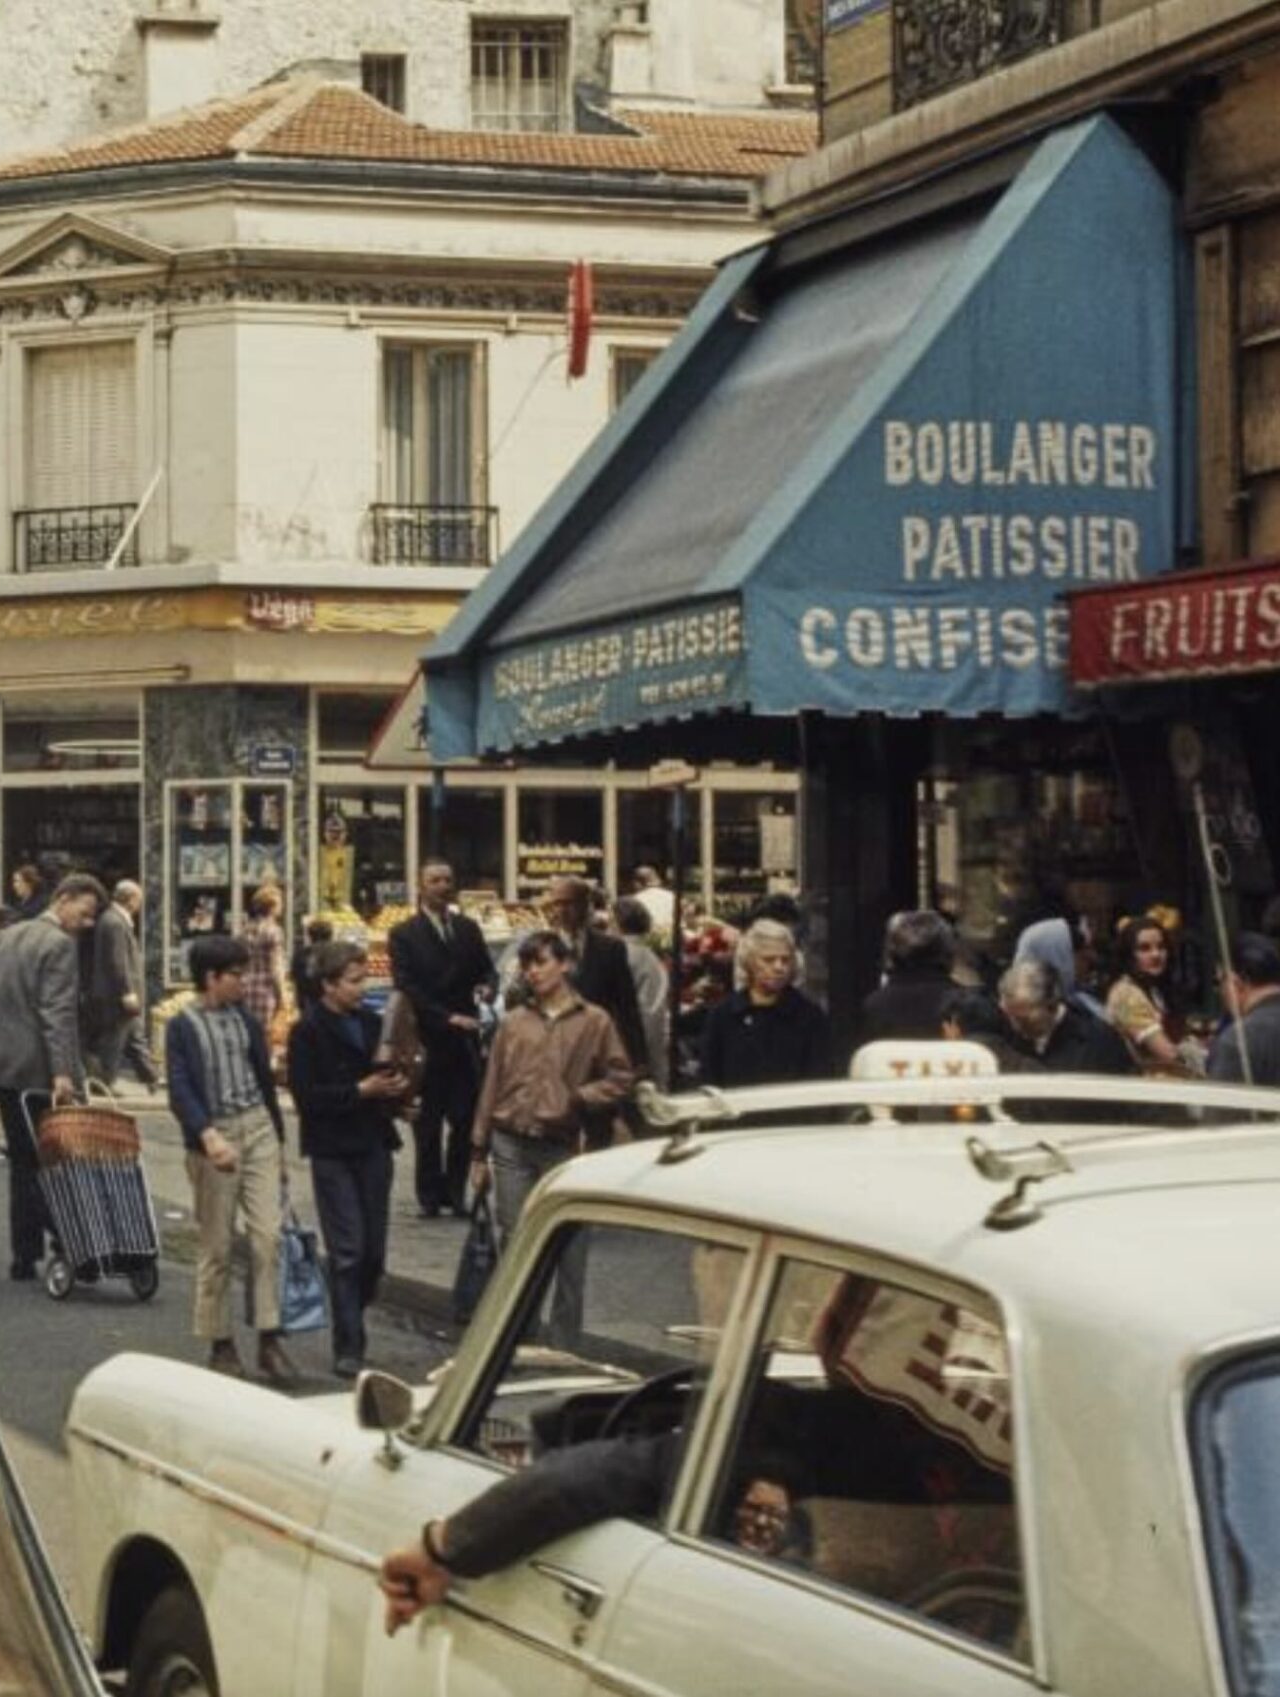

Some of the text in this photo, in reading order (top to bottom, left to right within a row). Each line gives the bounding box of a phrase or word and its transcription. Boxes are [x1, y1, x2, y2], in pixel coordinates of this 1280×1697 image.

[884, 421, 1155, 490] BOULANGER
[902, 515, 1140, 582] PATISSIER
[799, 607, 1070, 670] CONFISE
[1112, 583, 1280, 664] FRUITS
